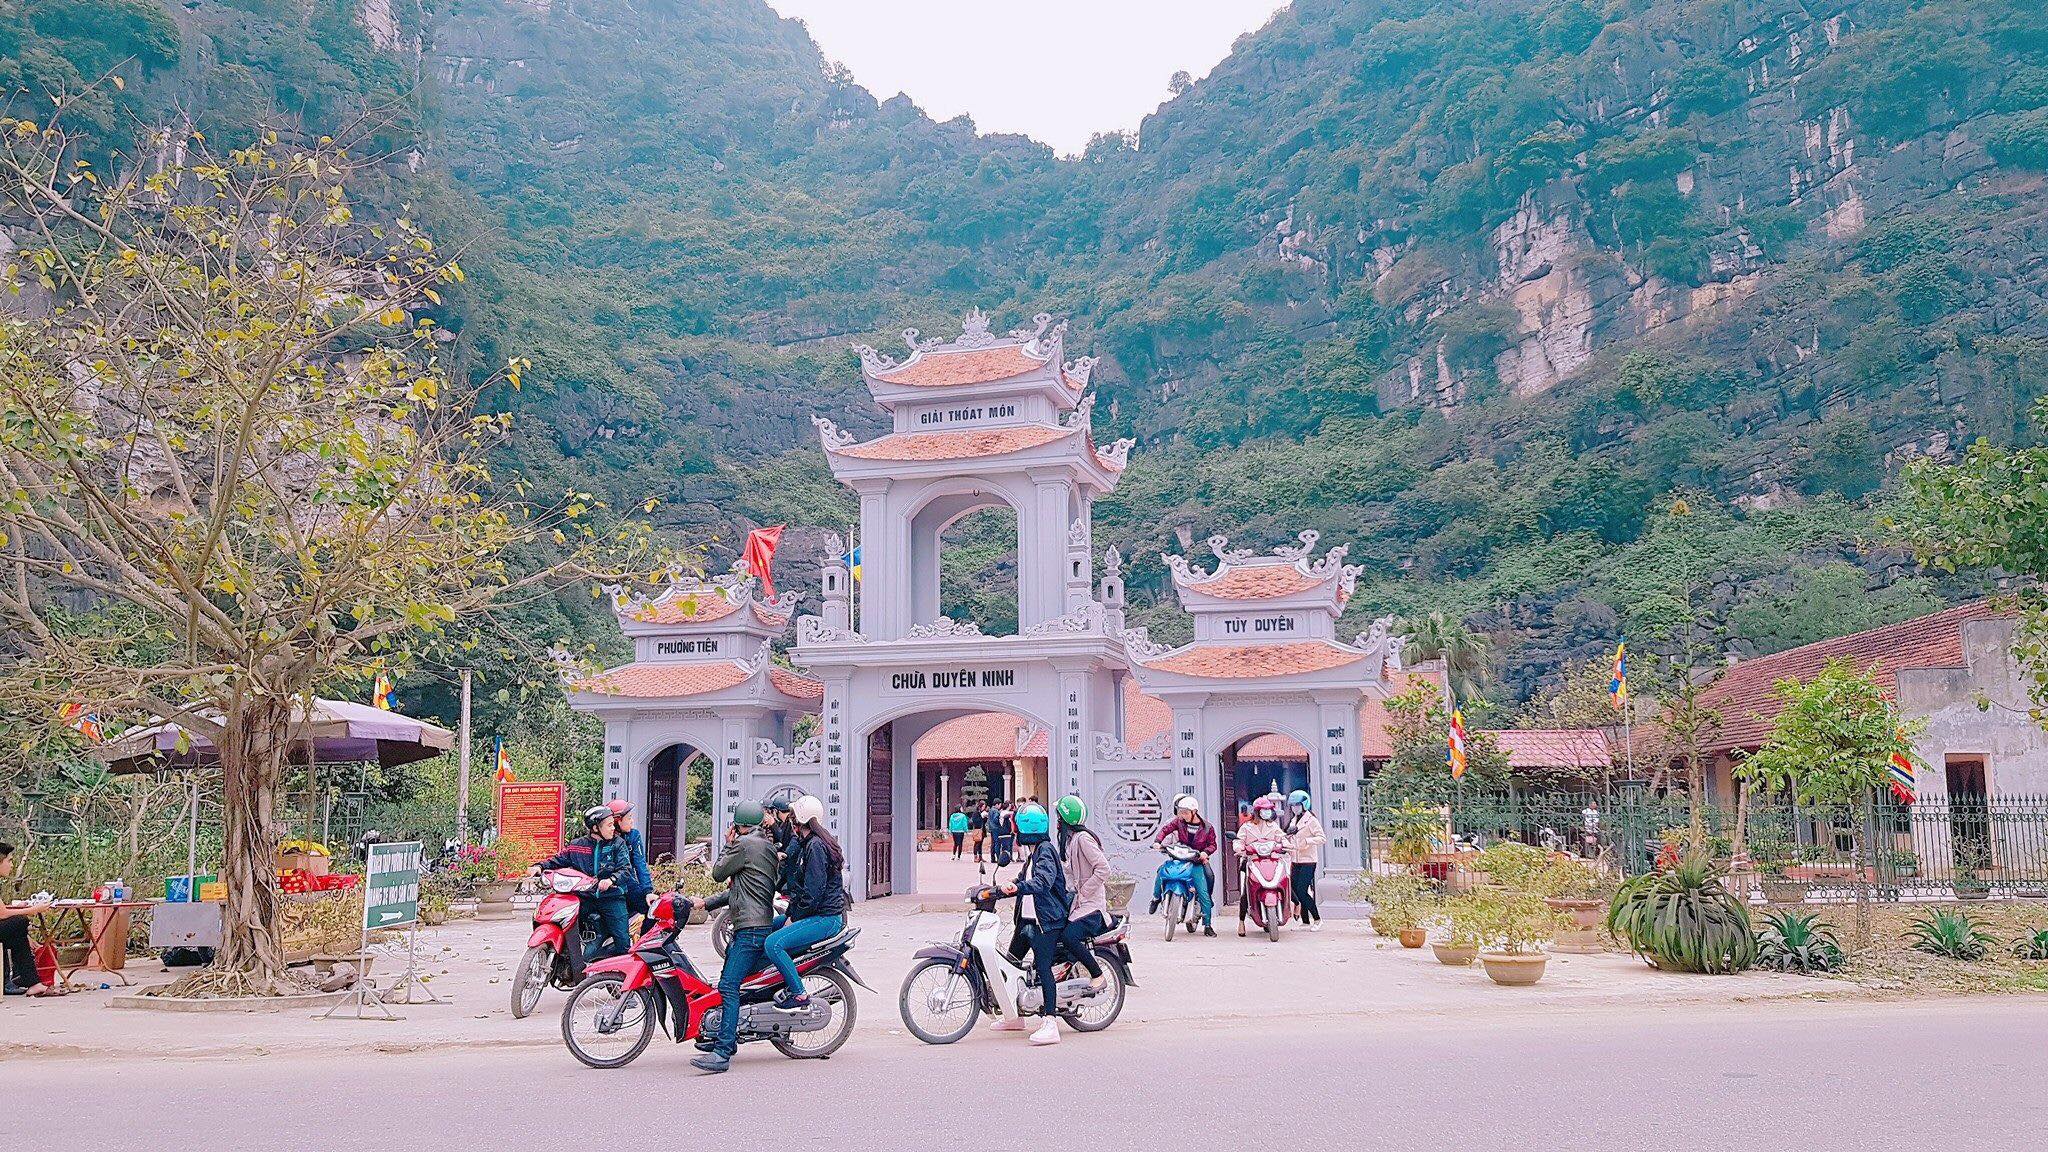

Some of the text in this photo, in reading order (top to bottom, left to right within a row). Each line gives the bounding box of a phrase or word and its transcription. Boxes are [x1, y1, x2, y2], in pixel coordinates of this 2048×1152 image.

[921, 409, 943, 424] GIẢI
[988, 404, 1015, 418] MÔN
[1255, 614, 1294, 631] DUYÊN
[697, 637, 718, 655] TIỆN
[892, 669, 1014, 689] CHÙA DUYÊN NINH
